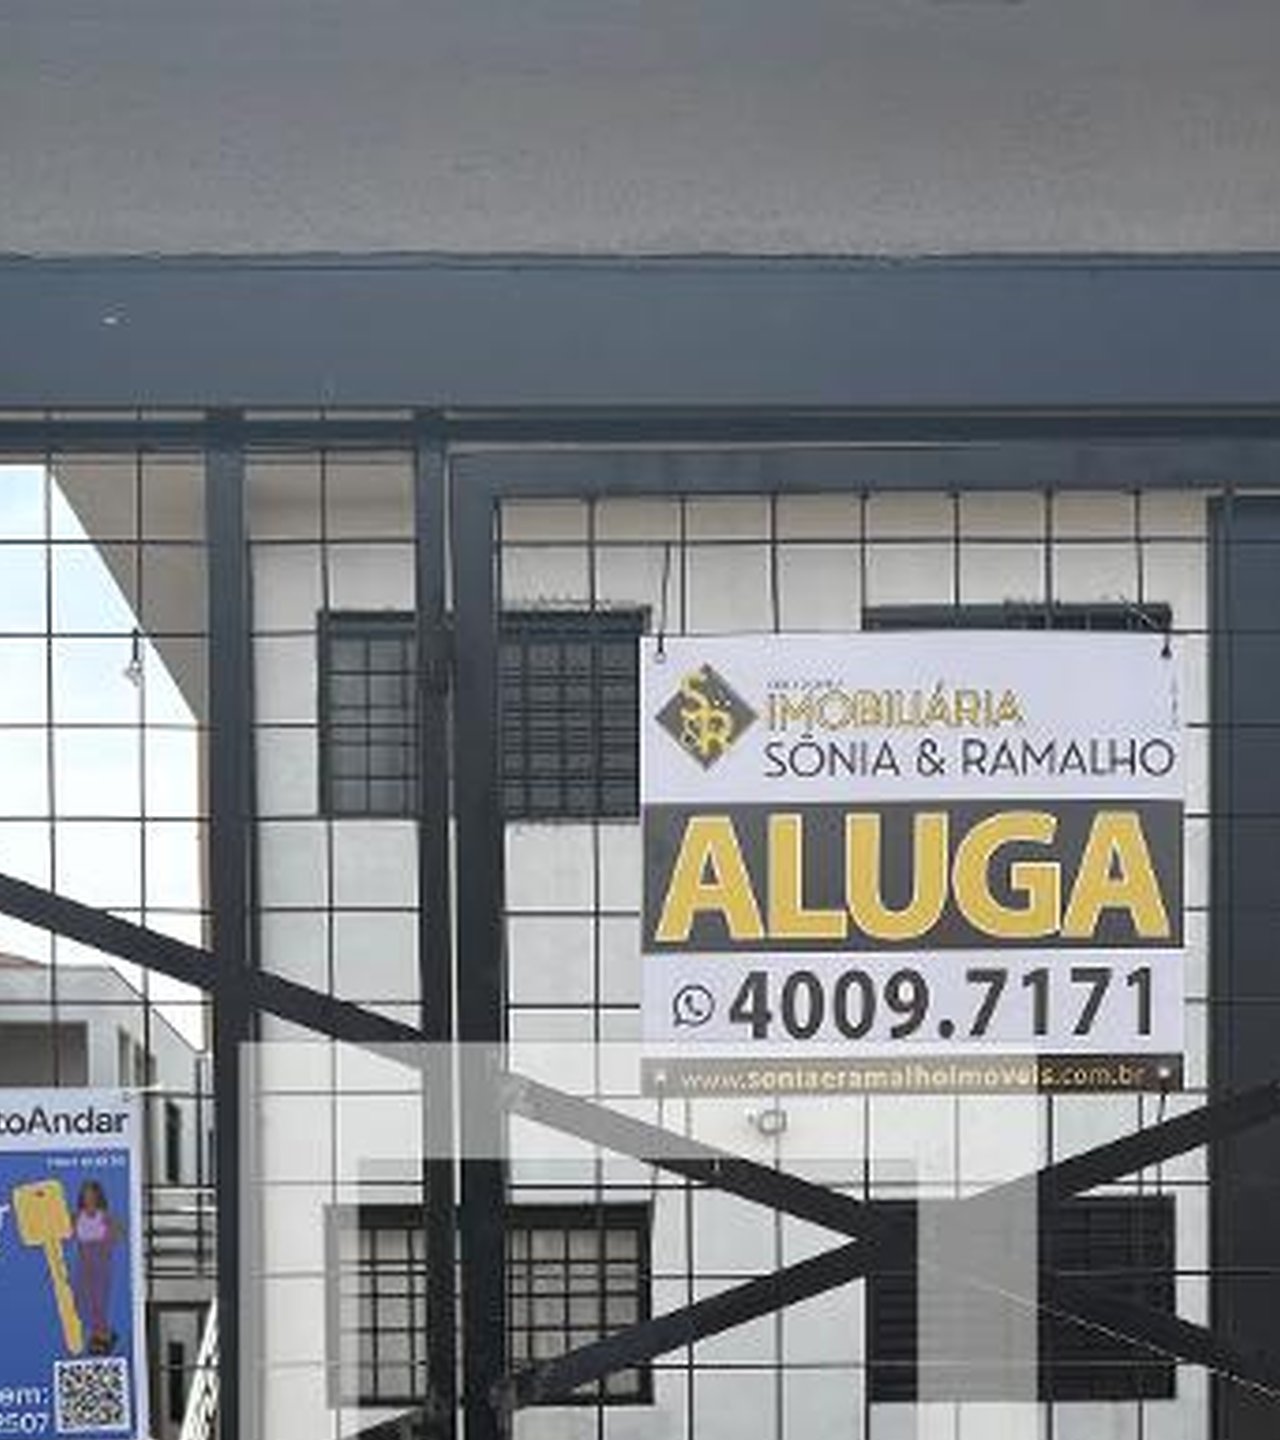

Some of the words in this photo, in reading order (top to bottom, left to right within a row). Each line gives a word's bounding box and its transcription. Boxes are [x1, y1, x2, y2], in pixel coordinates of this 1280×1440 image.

[766, 680, 1025, 732] IMOBILIÁRIA
[764, 733, 901, 778] SÔNIA
[917, 738, 946, 777] &
[962, 736, 1177, 778] RAMALHO
[654, 810, 1173, 942] ALUGA
[727, 966, 1152, 1042] 4009.7171
